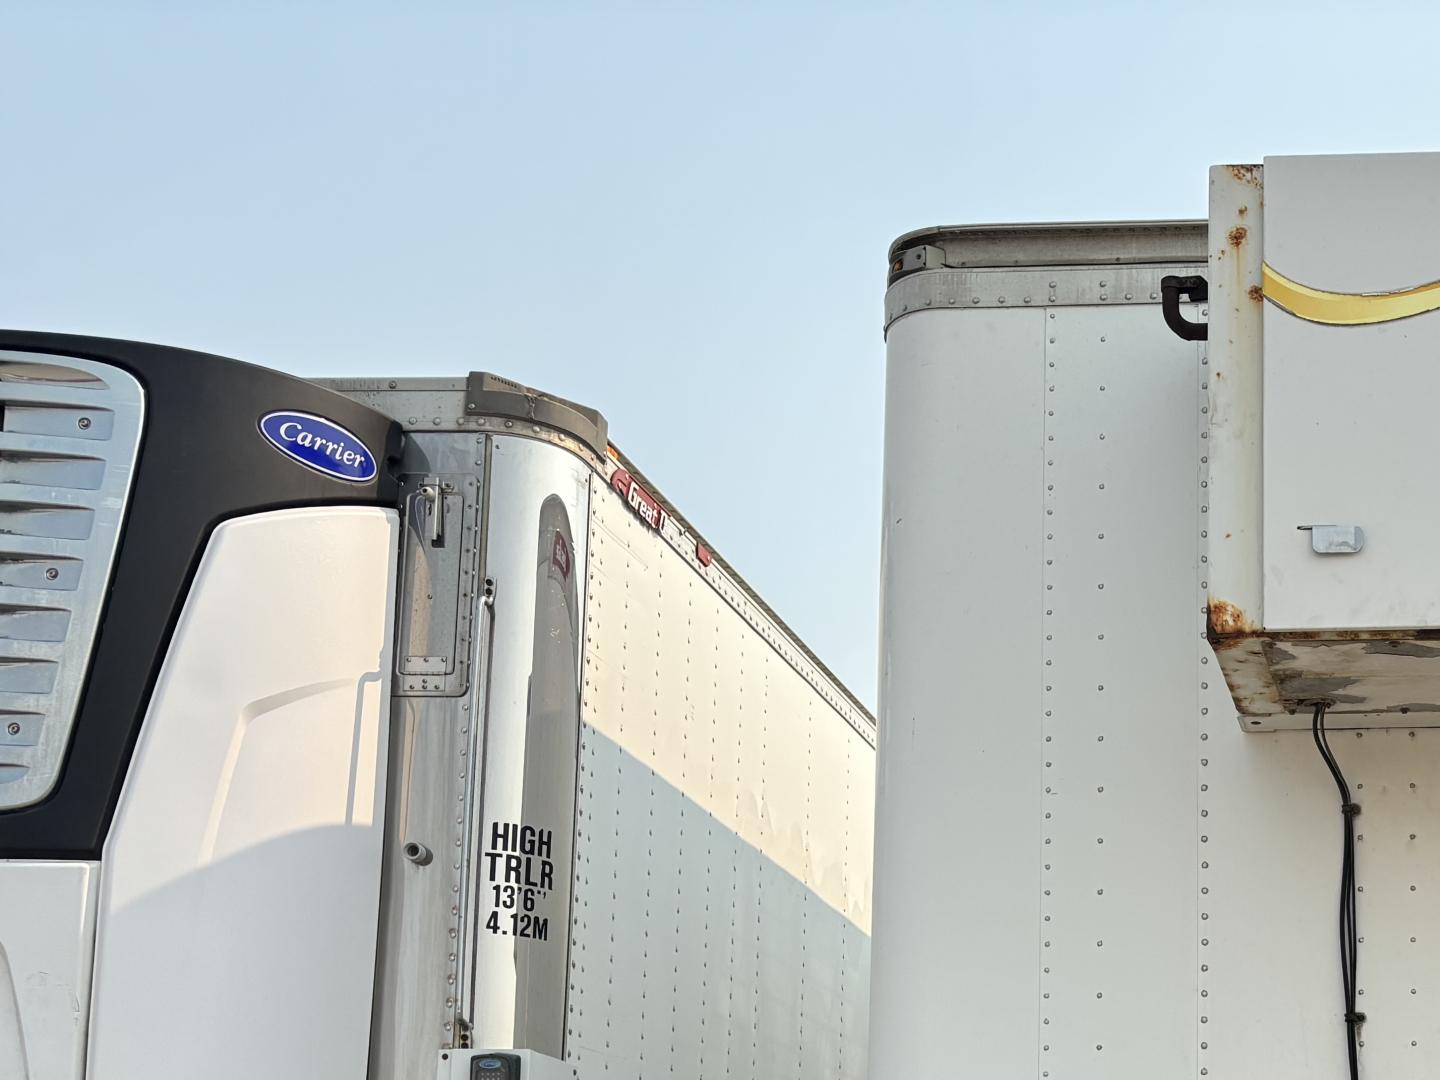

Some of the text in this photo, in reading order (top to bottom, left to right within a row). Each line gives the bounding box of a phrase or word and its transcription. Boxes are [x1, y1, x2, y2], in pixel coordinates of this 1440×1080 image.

[279, 422, 365, 468] Carrier
[627, 481, 659, 529] Great
[490, 821, 553, 860] HIGH
[484, 851, 554, 891] TRLR
[485, 910, 549, 941] 4.12M
